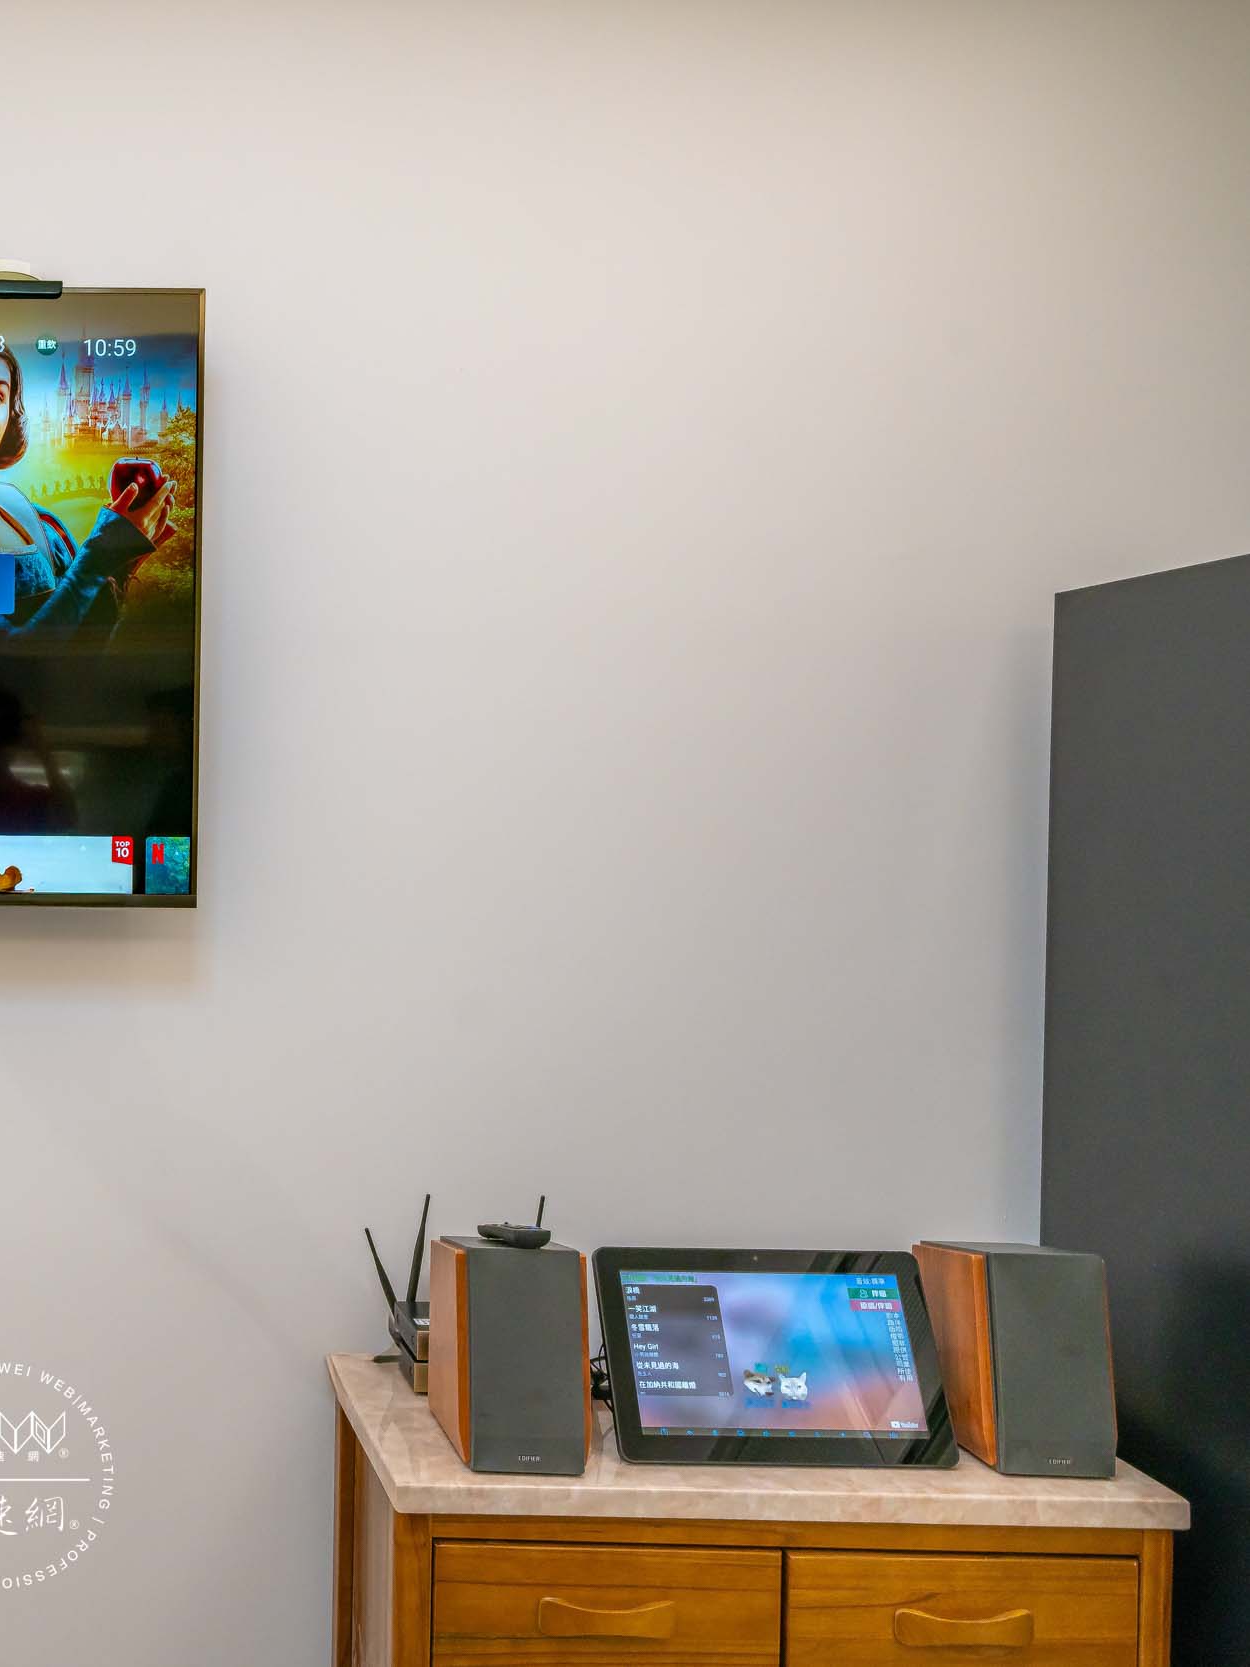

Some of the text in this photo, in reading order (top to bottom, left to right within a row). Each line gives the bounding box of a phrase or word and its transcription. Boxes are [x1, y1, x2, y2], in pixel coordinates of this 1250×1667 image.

[83, 338, 137, 357] 10:59
[115, 847, 130, 858] 10
[152, 843, 165, 864] N
[633, 1343, 646, 1351] Hey
